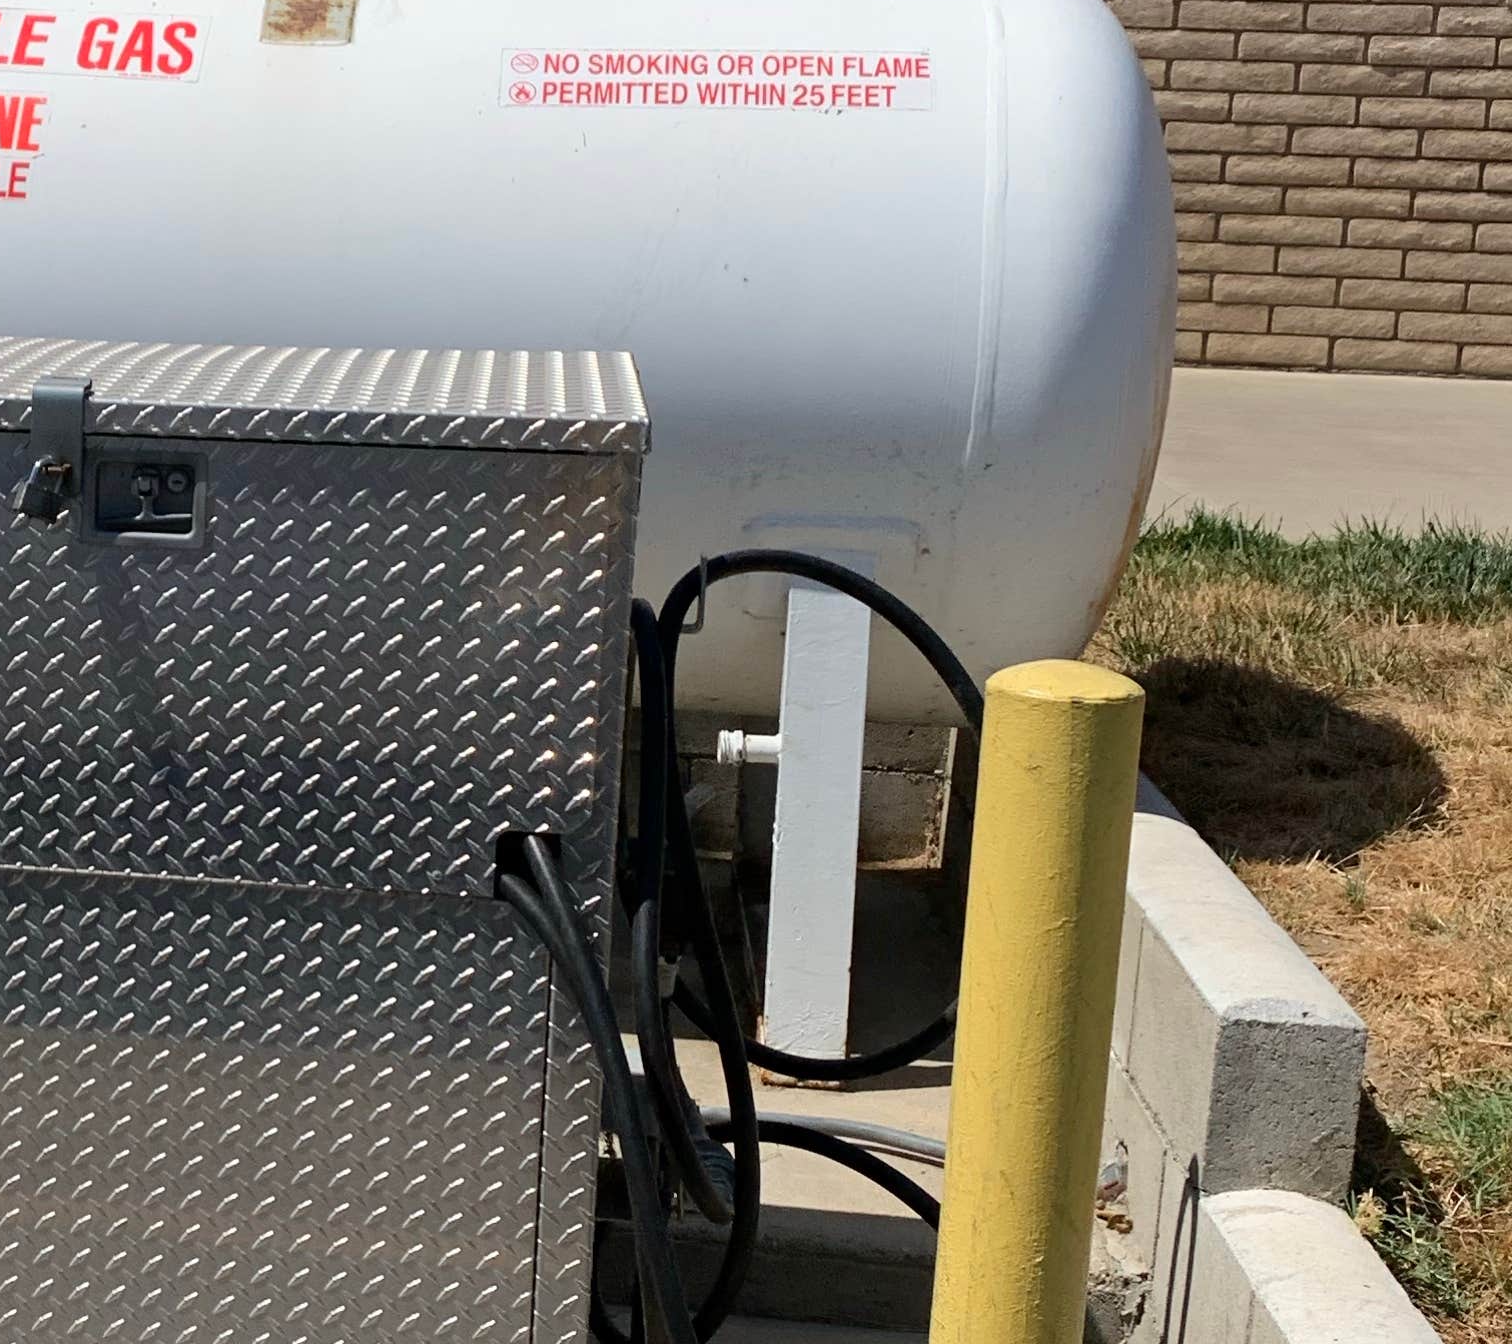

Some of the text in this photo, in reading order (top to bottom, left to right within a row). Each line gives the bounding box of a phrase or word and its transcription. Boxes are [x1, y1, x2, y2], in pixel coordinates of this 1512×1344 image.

[77, 17, 197, 75] GAS
[543, 54, 930, 78] NO SMOKING OR OPEN FLAME
[542, 82, 896, 107] PERMITTED WITHIN 25 FEET
